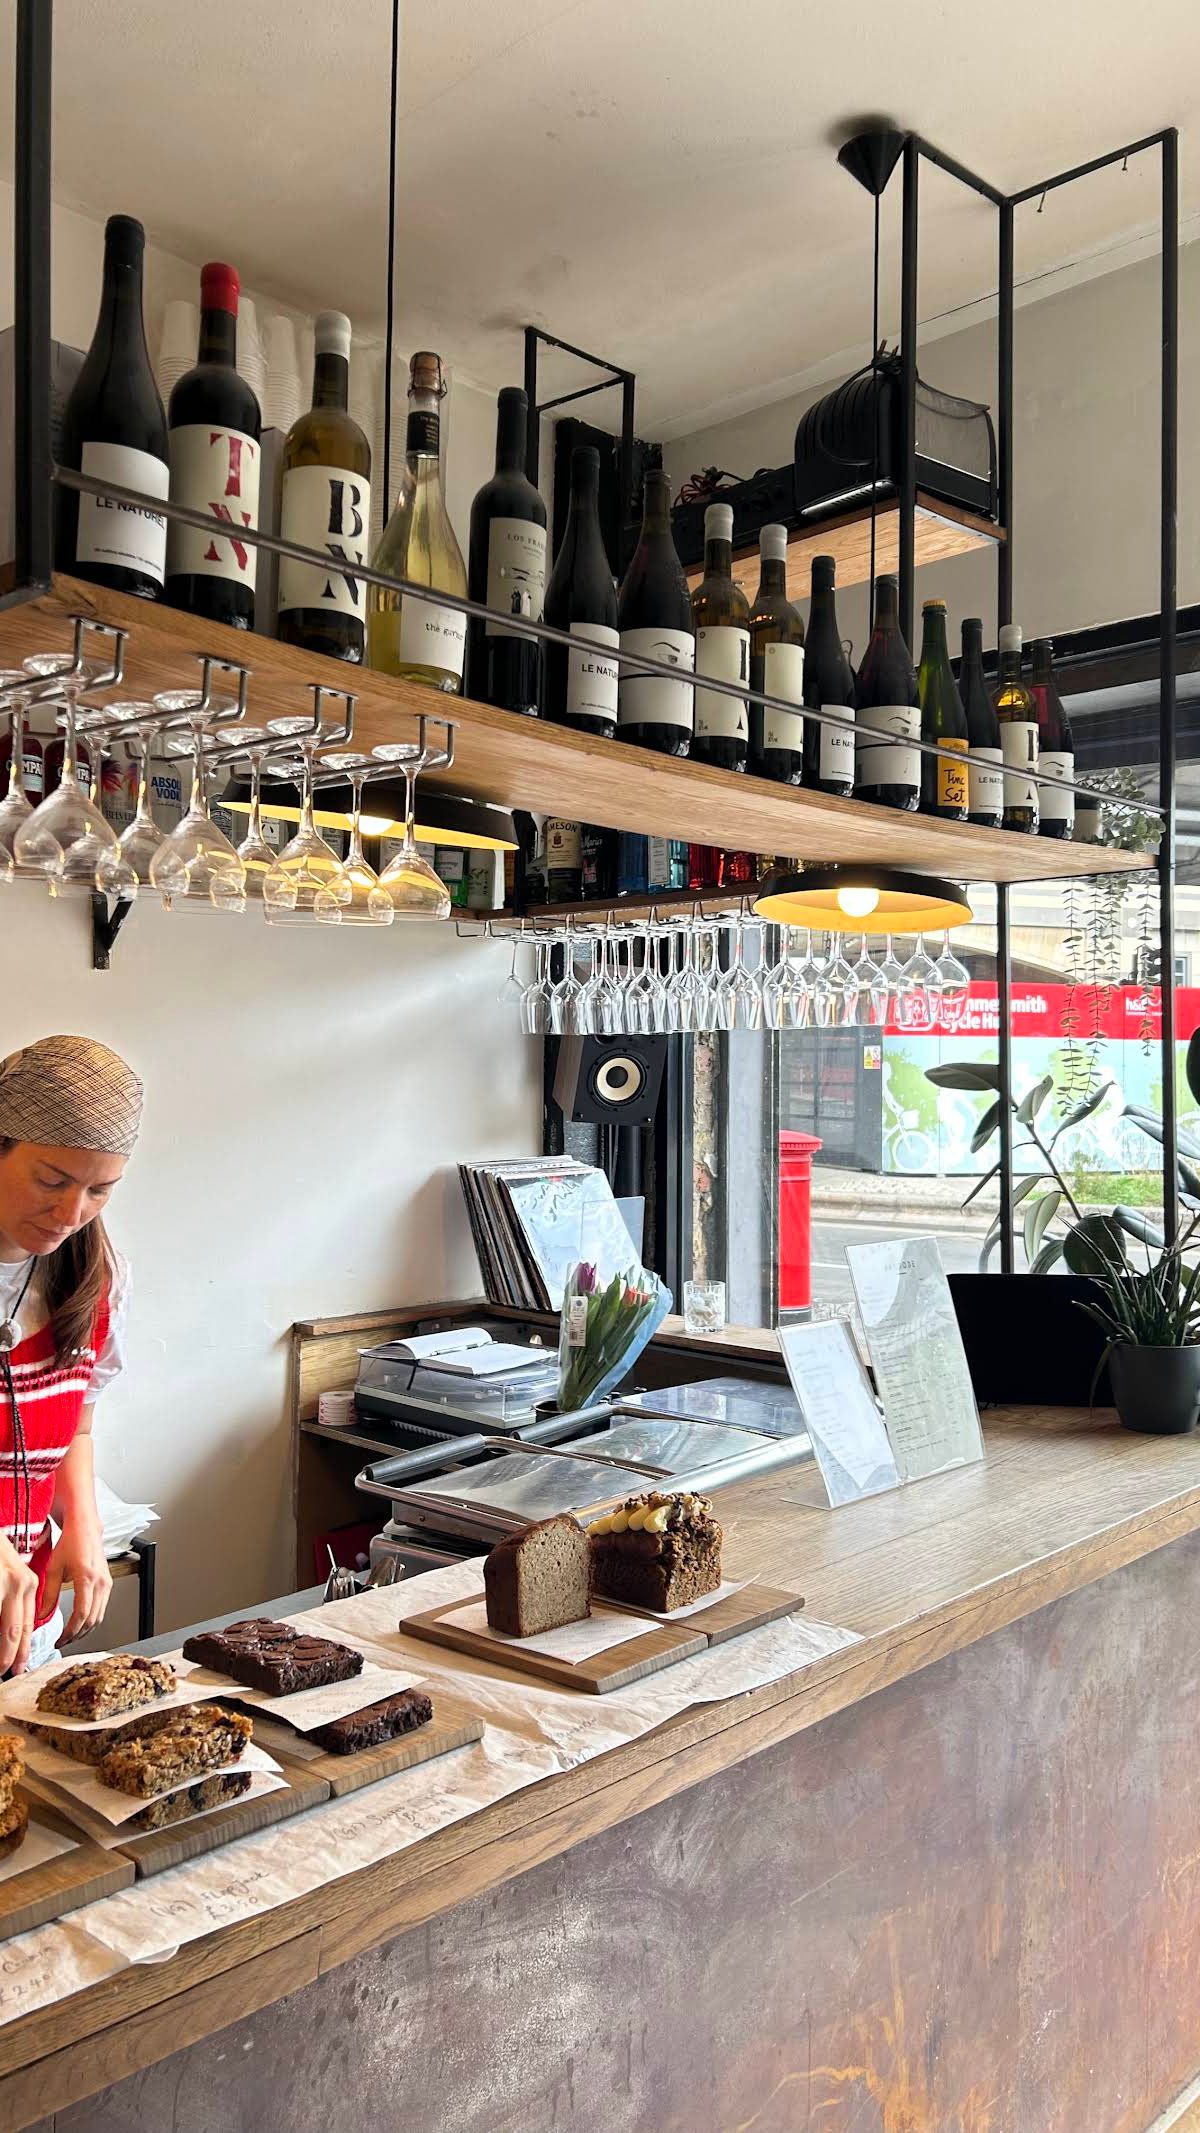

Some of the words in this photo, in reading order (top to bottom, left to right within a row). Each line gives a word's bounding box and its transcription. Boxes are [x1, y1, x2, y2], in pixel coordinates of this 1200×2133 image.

[581, 663, 594, 673] LE
[831, 738, 841, 746] LE
[978, 776, 988, 784] LE
